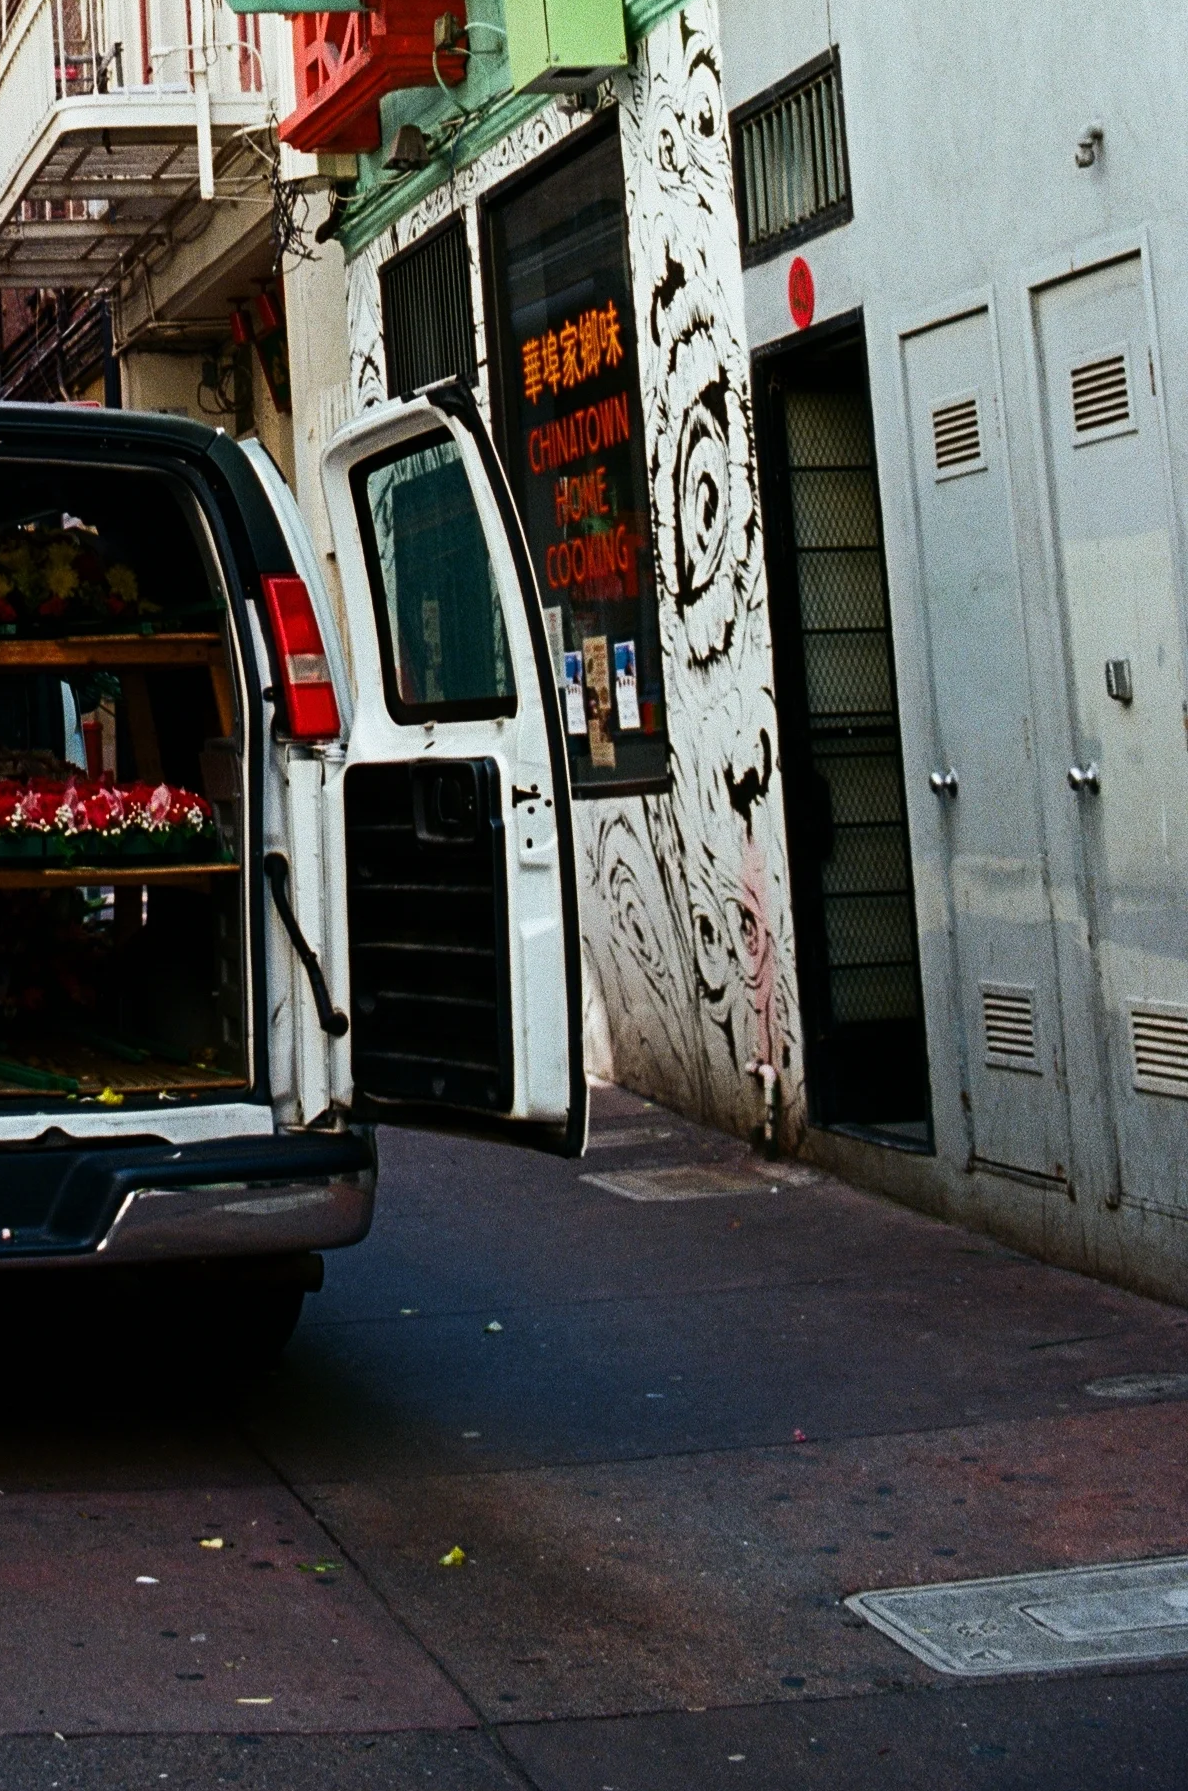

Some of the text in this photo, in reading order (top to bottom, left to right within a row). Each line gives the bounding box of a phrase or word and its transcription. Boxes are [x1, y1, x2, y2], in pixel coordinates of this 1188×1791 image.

[521, 299, 624, 405] 華埠家鄉味
[527, 391, 632, 475] CHINATOWN
[555, 465, 610, 528] HOME
[545, 522, 630, 590] COOKING
